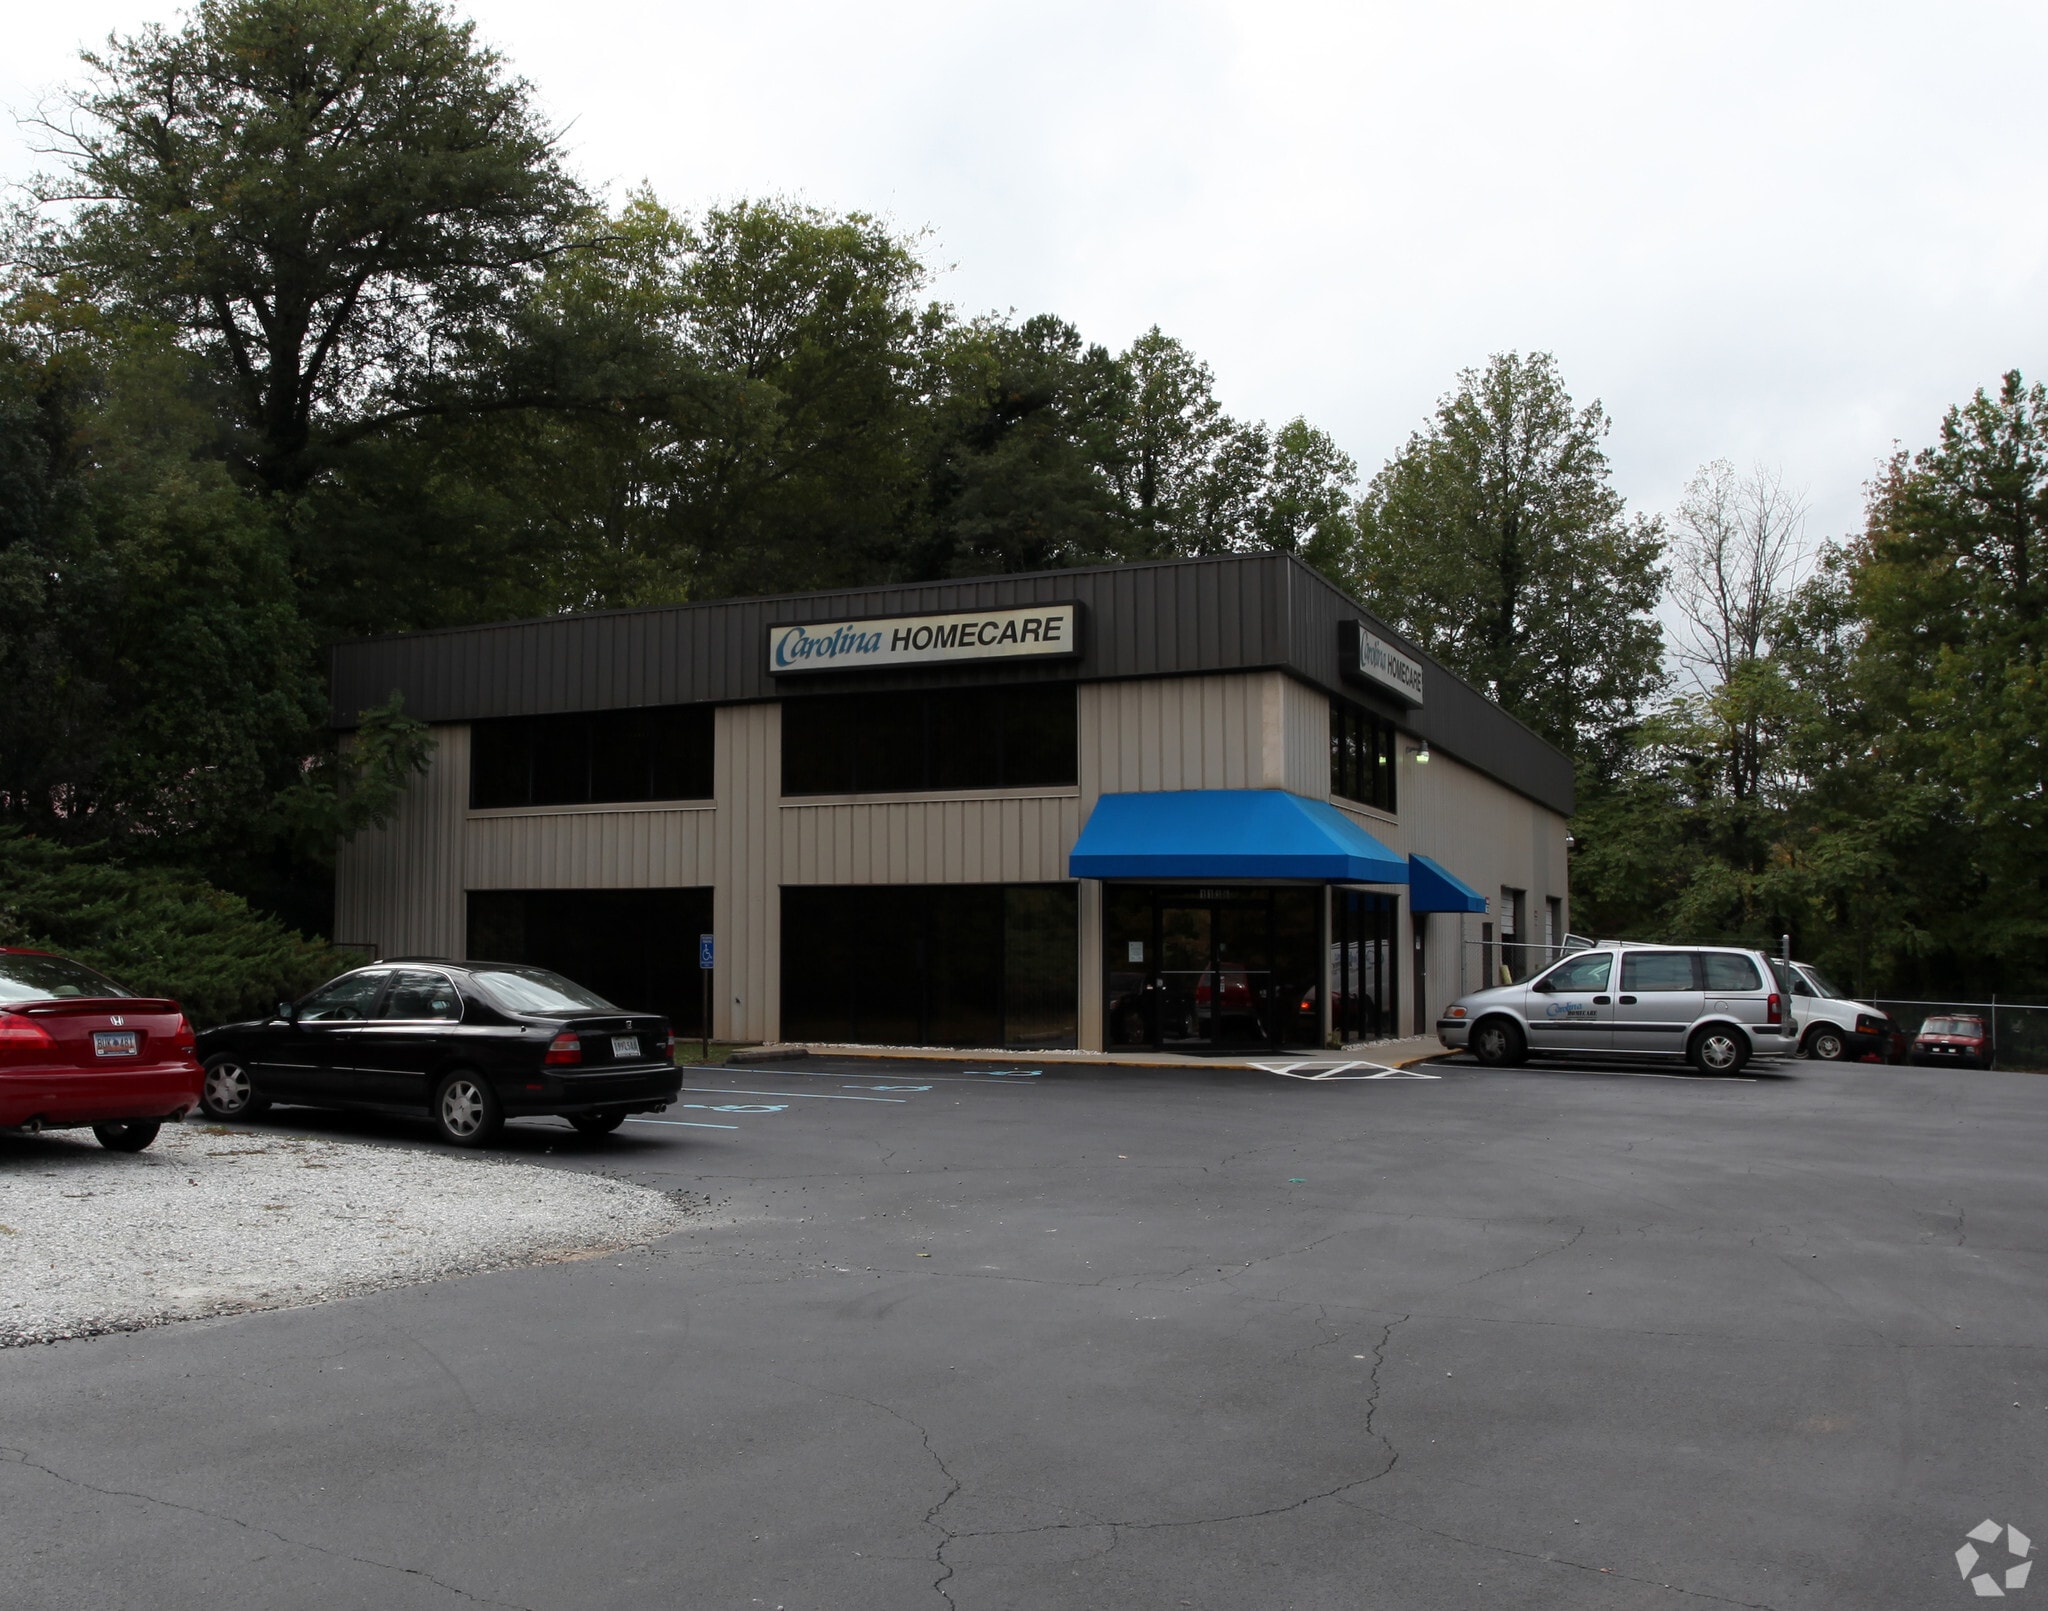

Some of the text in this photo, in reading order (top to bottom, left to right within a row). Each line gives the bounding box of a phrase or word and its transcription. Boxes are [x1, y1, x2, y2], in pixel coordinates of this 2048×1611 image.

[776, 616, 1064, 667] Carolina HOMECARE
[1387, 652, 1421, 693] HOMECARE
